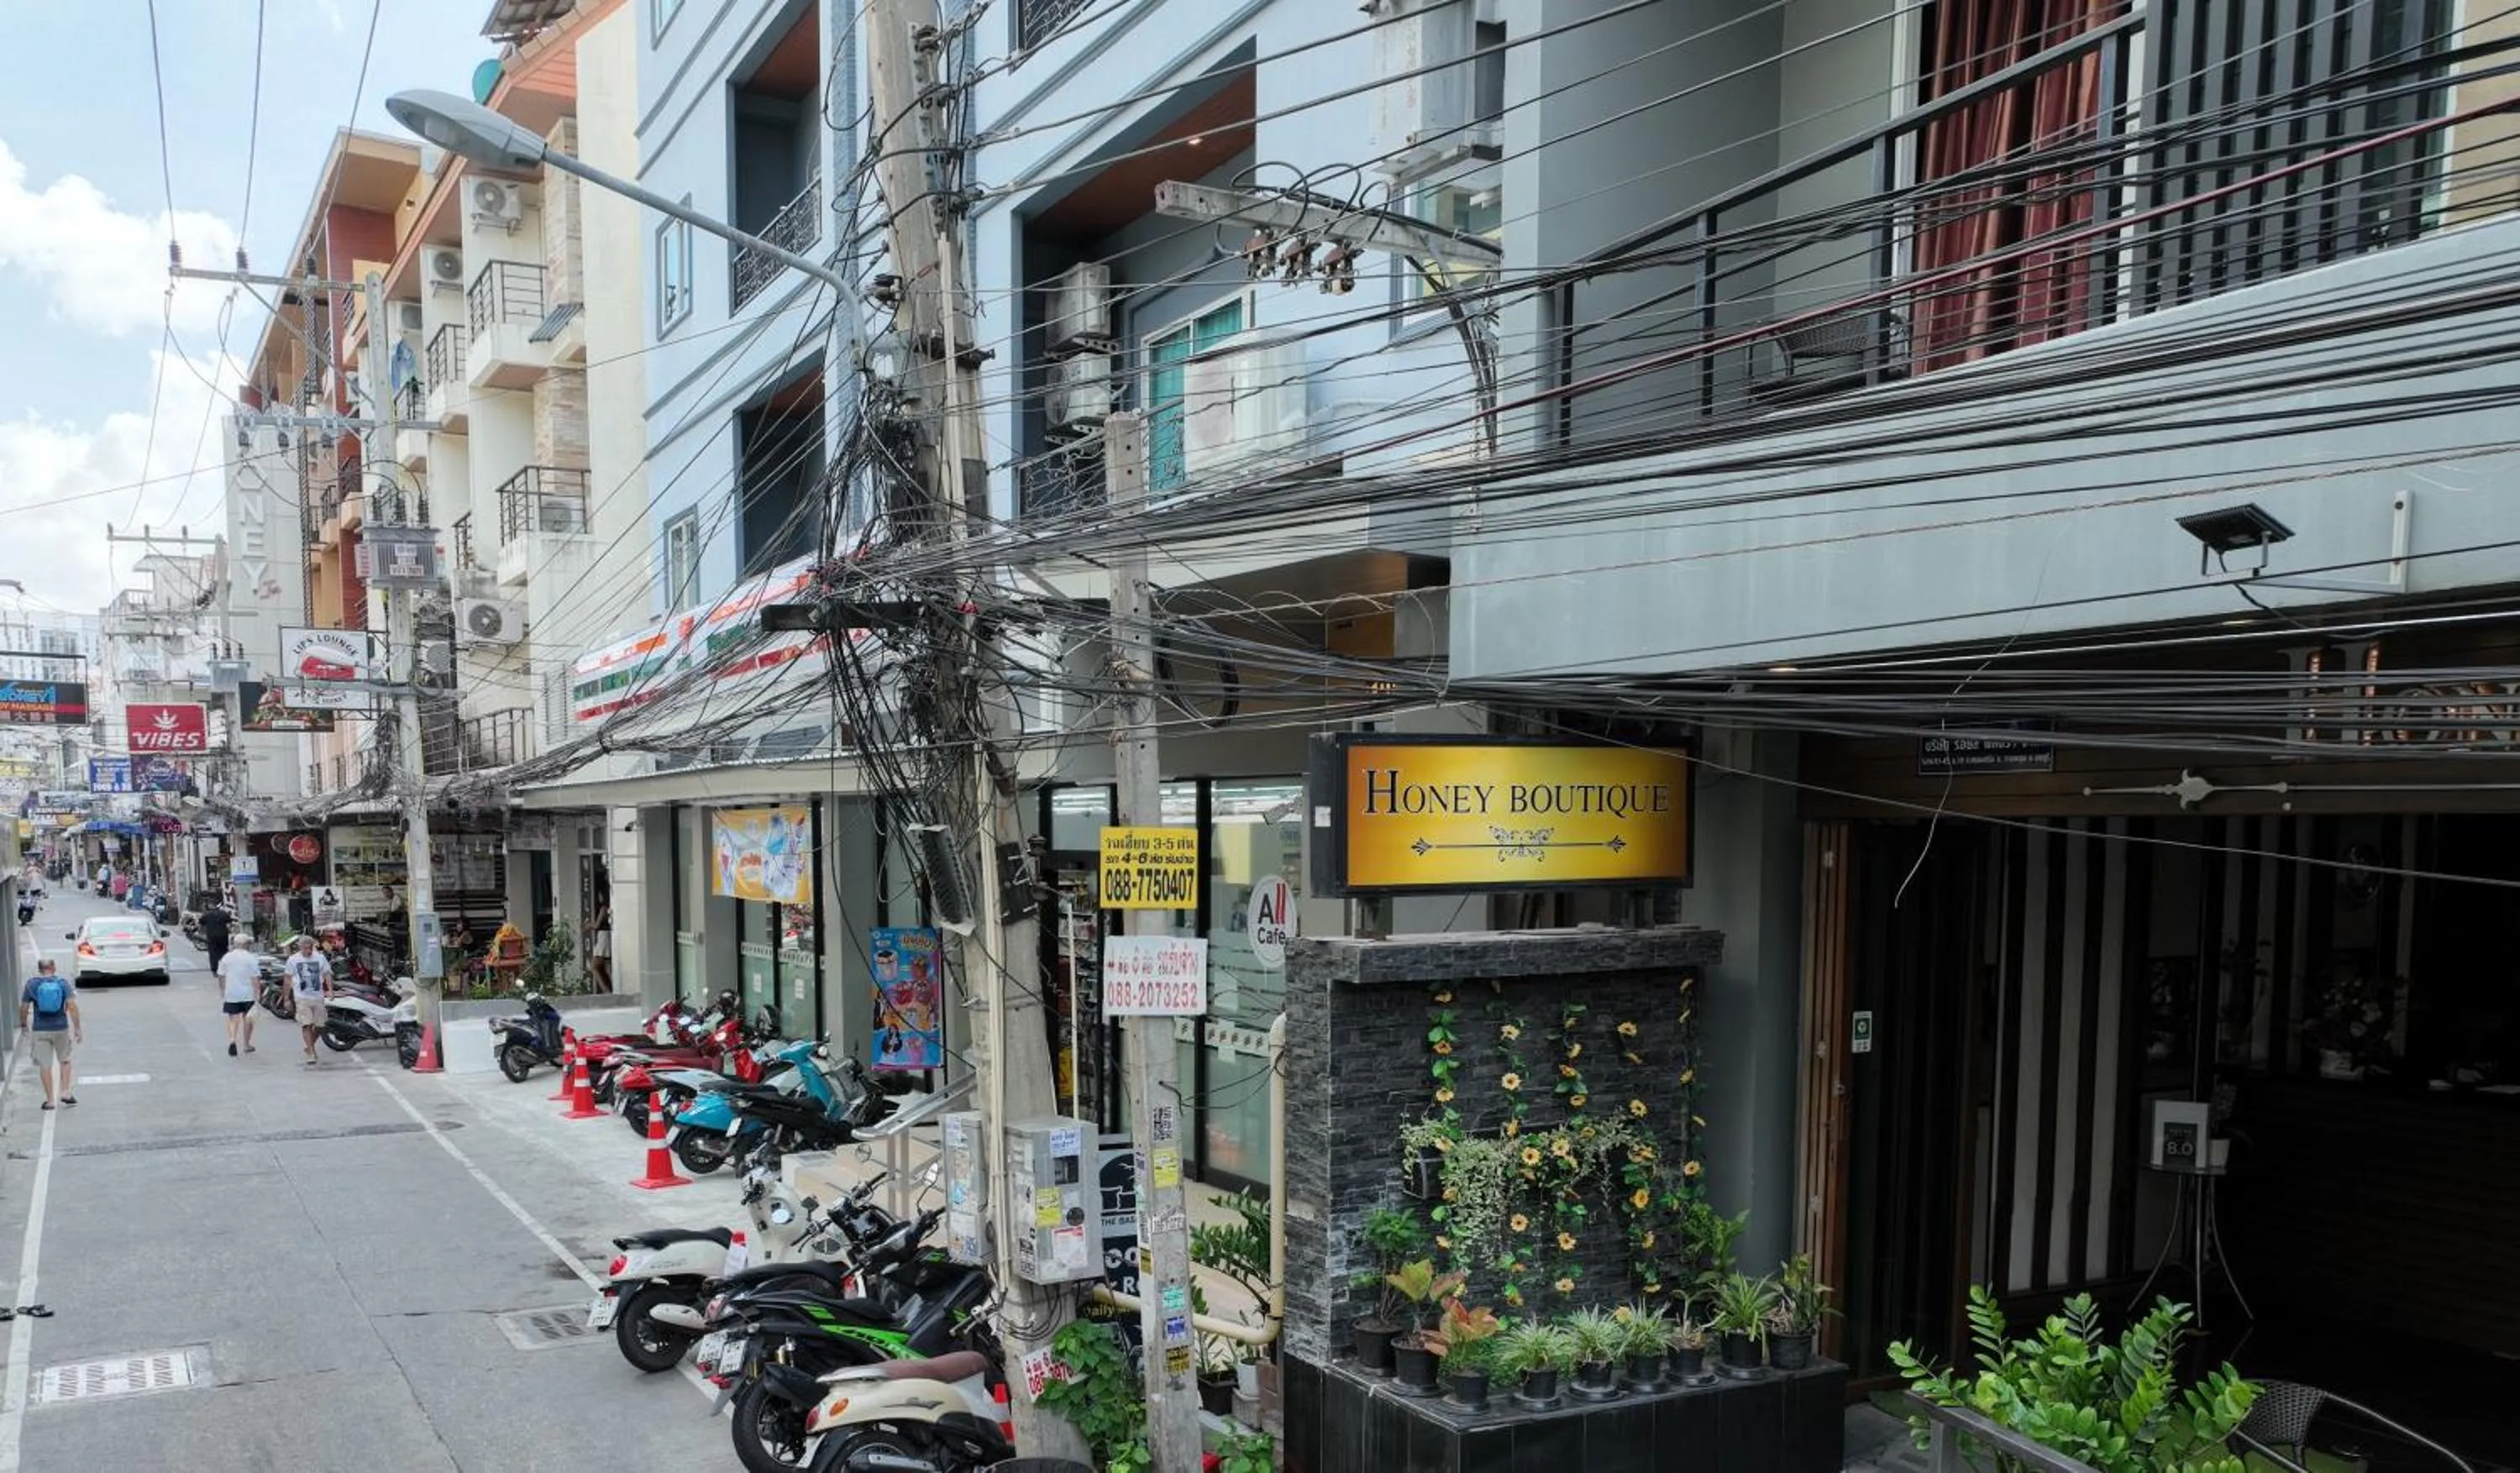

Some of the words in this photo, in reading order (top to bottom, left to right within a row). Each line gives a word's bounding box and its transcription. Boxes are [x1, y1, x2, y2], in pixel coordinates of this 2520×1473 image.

[317, 634, 359, 656] LOUNGE
[131, 731, 201, 747] VIBES
[1363, 769, 1494, 814] HONEY
[1509, 783, 1669, 815] BOUTIQUE
[1153, 836, 1174, 850] 3-5
[1121, 852, 1148, 864] 4-6
[1105, 868, 1194, 901] 088-7750407
[1258, 883, 1286, 925] All
[1101, 1217, 1116, 1227] THE
